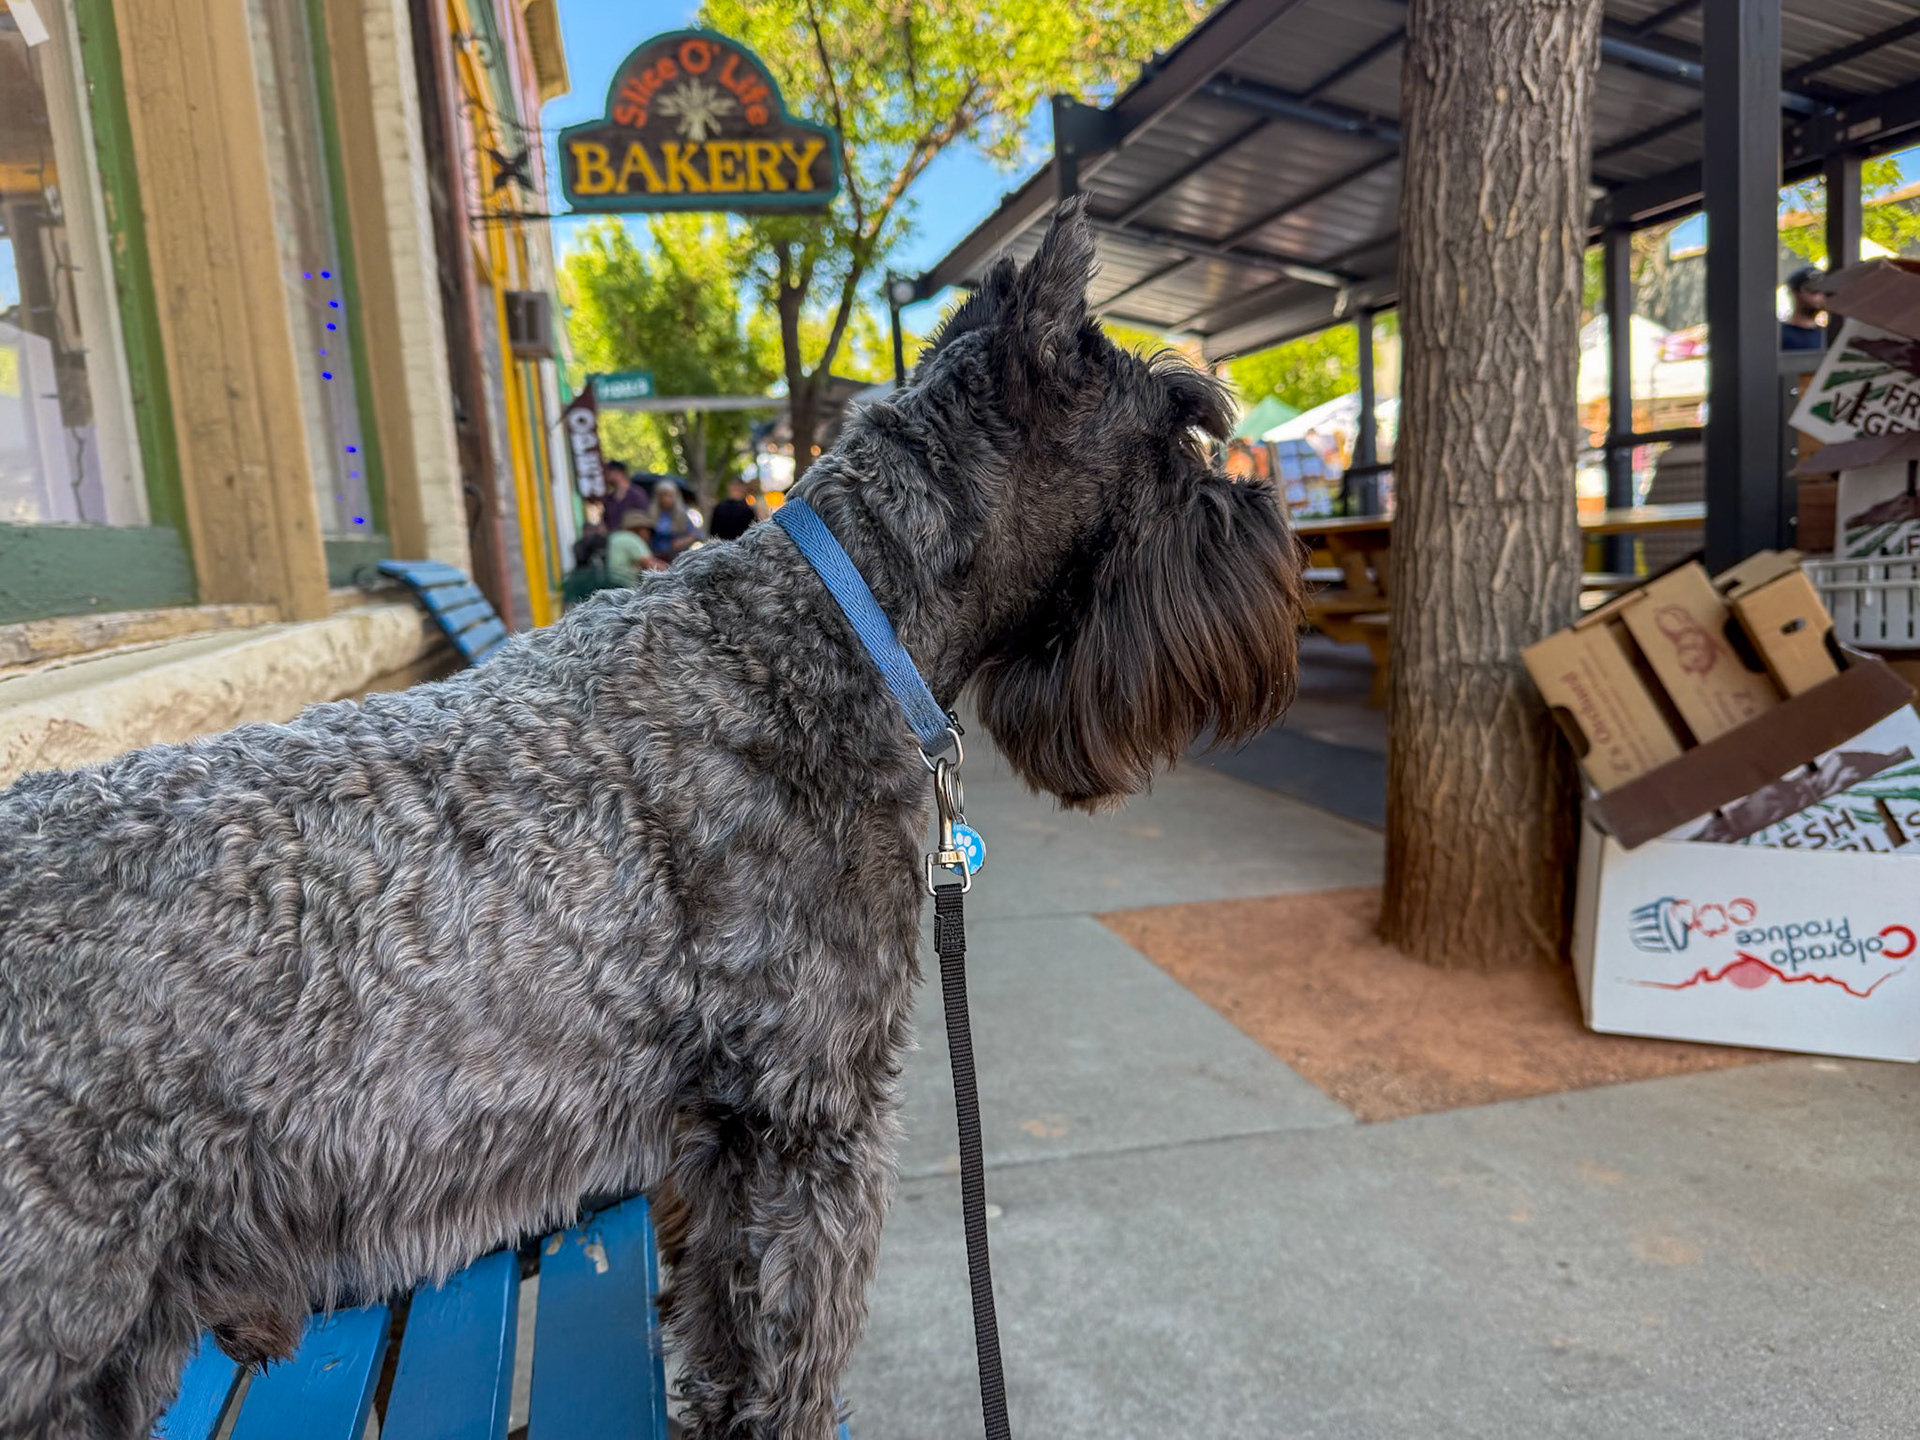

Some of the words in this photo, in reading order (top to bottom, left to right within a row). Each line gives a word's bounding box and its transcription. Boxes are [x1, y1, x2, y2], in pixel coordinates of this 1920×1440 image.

[613, 57, 678, 128] Slice
[569, 140, 826, 194] BAKERY
[567, 407, 606, 498] OPEN
[1735, 917, 1850, 949] Produce
[1770, 924, 1917, 972] Colorado
